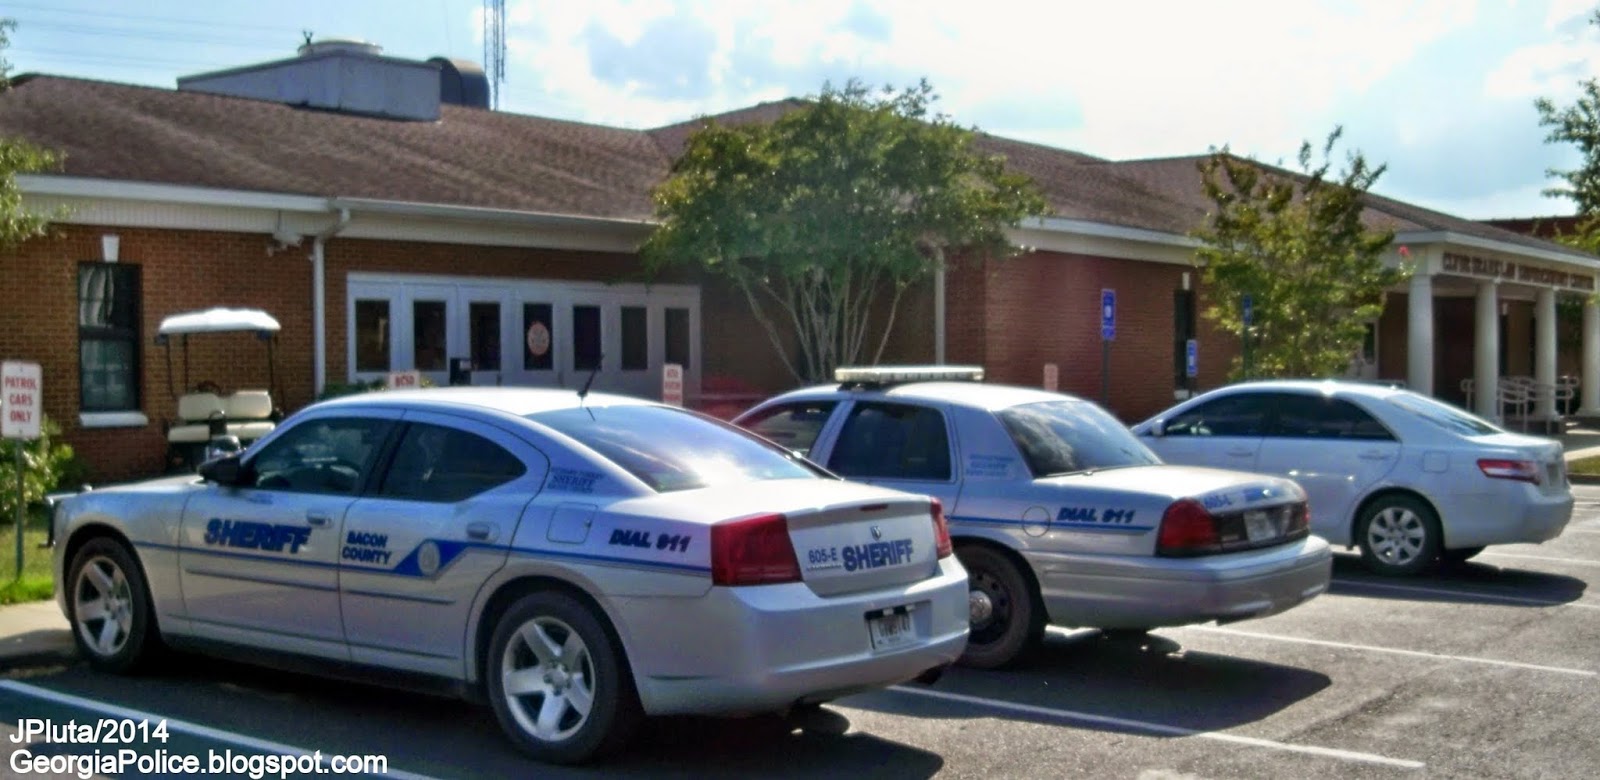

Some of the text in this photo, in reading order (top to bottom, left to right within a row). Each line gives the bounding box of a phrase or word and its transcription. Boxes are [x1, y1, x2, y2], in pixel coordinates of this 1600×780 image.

[4, 375, 37, 390] PATROL
[9, 393, 33, 406] CARS
[10, 410, 33, 422] ONLY
[1056, 506, 1137, 524] DIAL 911
[204, 517, 313, 554] SHERIFF
[347, 530, 389, 547] BACON
[608, 528, 692, 553] DIAL 911
[342, 547, 393, 565] COUNTY
[808, 538, 914, 572] 605-E SHERIFF
